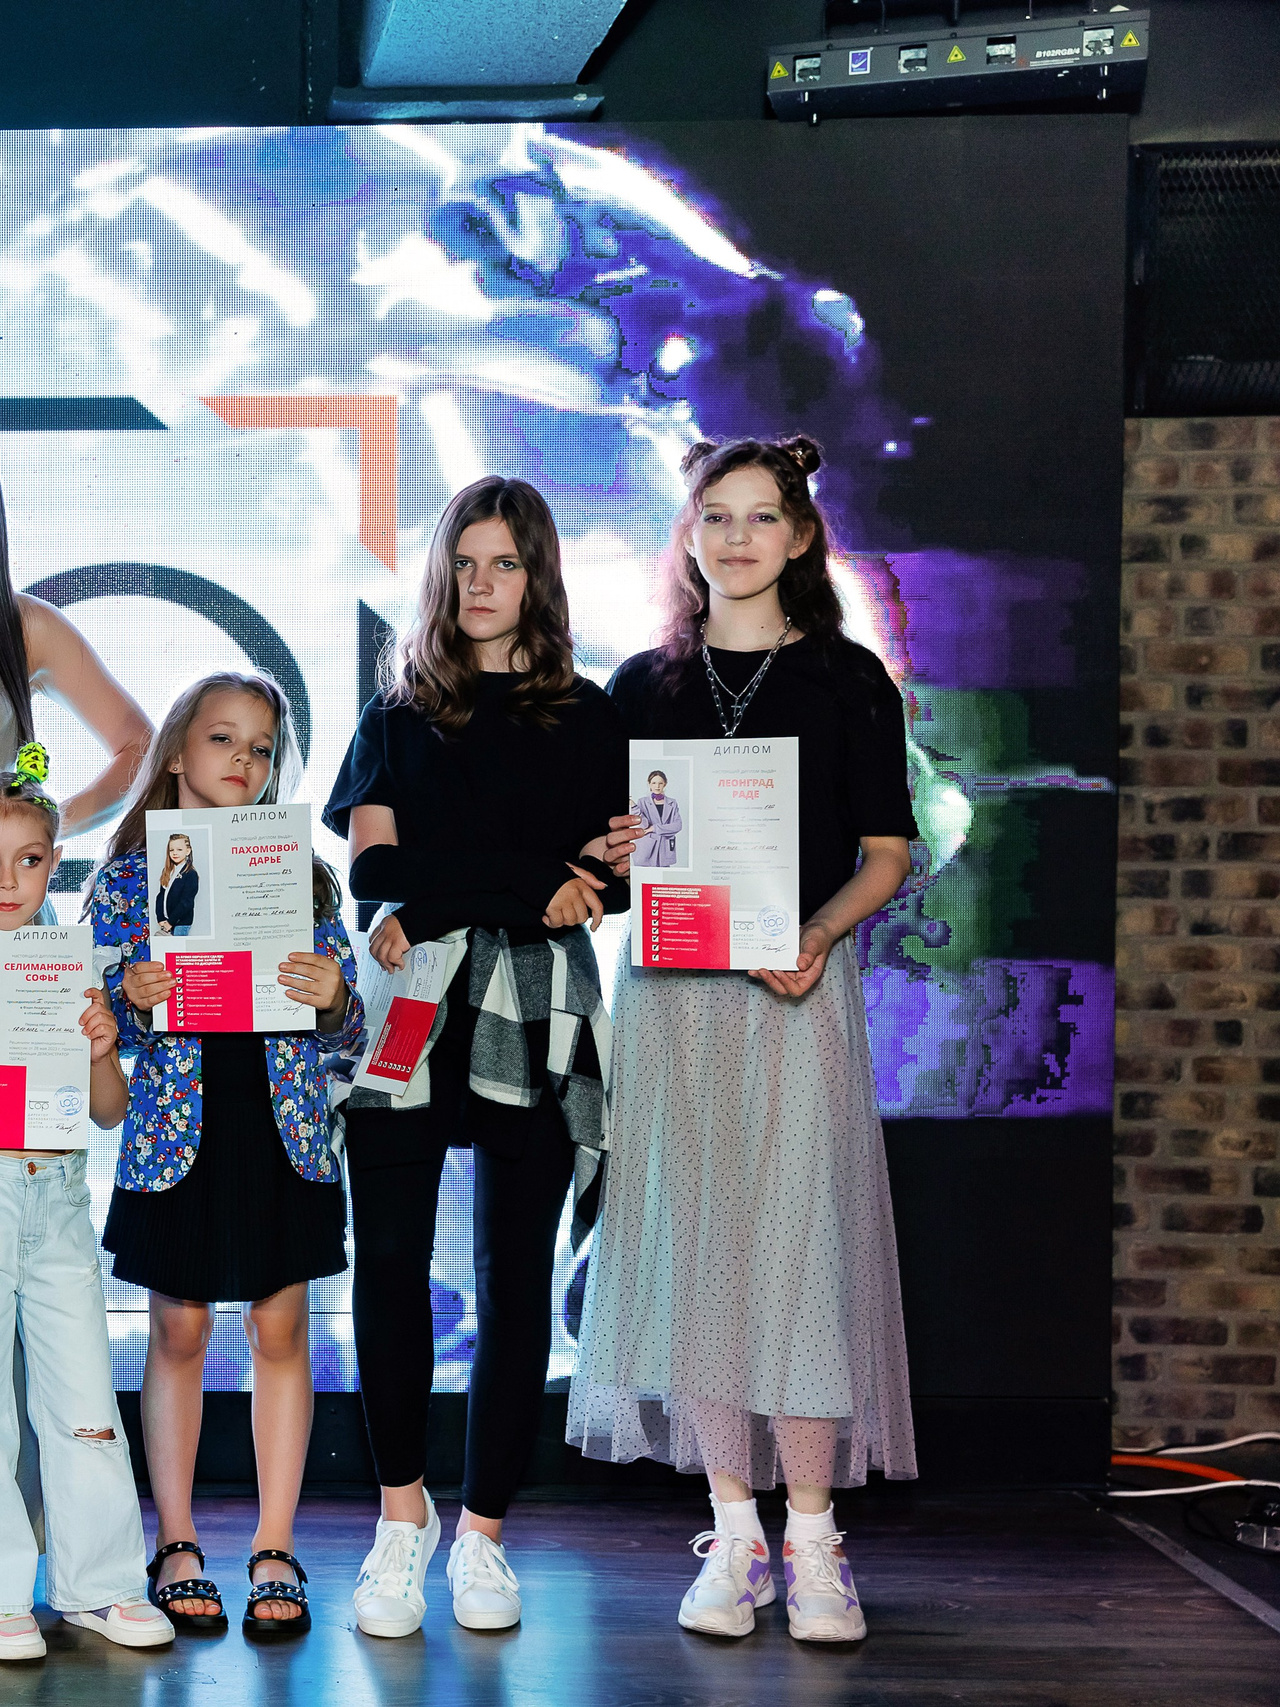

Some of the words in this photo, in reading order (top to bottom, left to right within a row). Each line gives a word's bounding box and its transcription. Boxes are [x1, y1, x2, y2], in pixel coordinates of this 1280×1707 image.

[714, 745, 772, 756] ДИПЛОМ
[718, 778, 774, 788] ЛЕОНГРАД
[732, 789, 760, 800] РАДЕ
[231, 810, 288, 823] ДИПЛОМ
[231, 842, 298, 854] ПАХОМОВОЙ
[249, 856, 282, 867] ДАРЬЕ
[733, 920, 754, 932] top
[14, 932, 68, 940] ДИПЛОМ
[4, 962, 84, 972] СЕЛИМАНОВОЙ
[25, 974, 58, 982] СОФЬЕ
[256, 984, 276, 996] top
[28, 1100, 50, 1112] top
